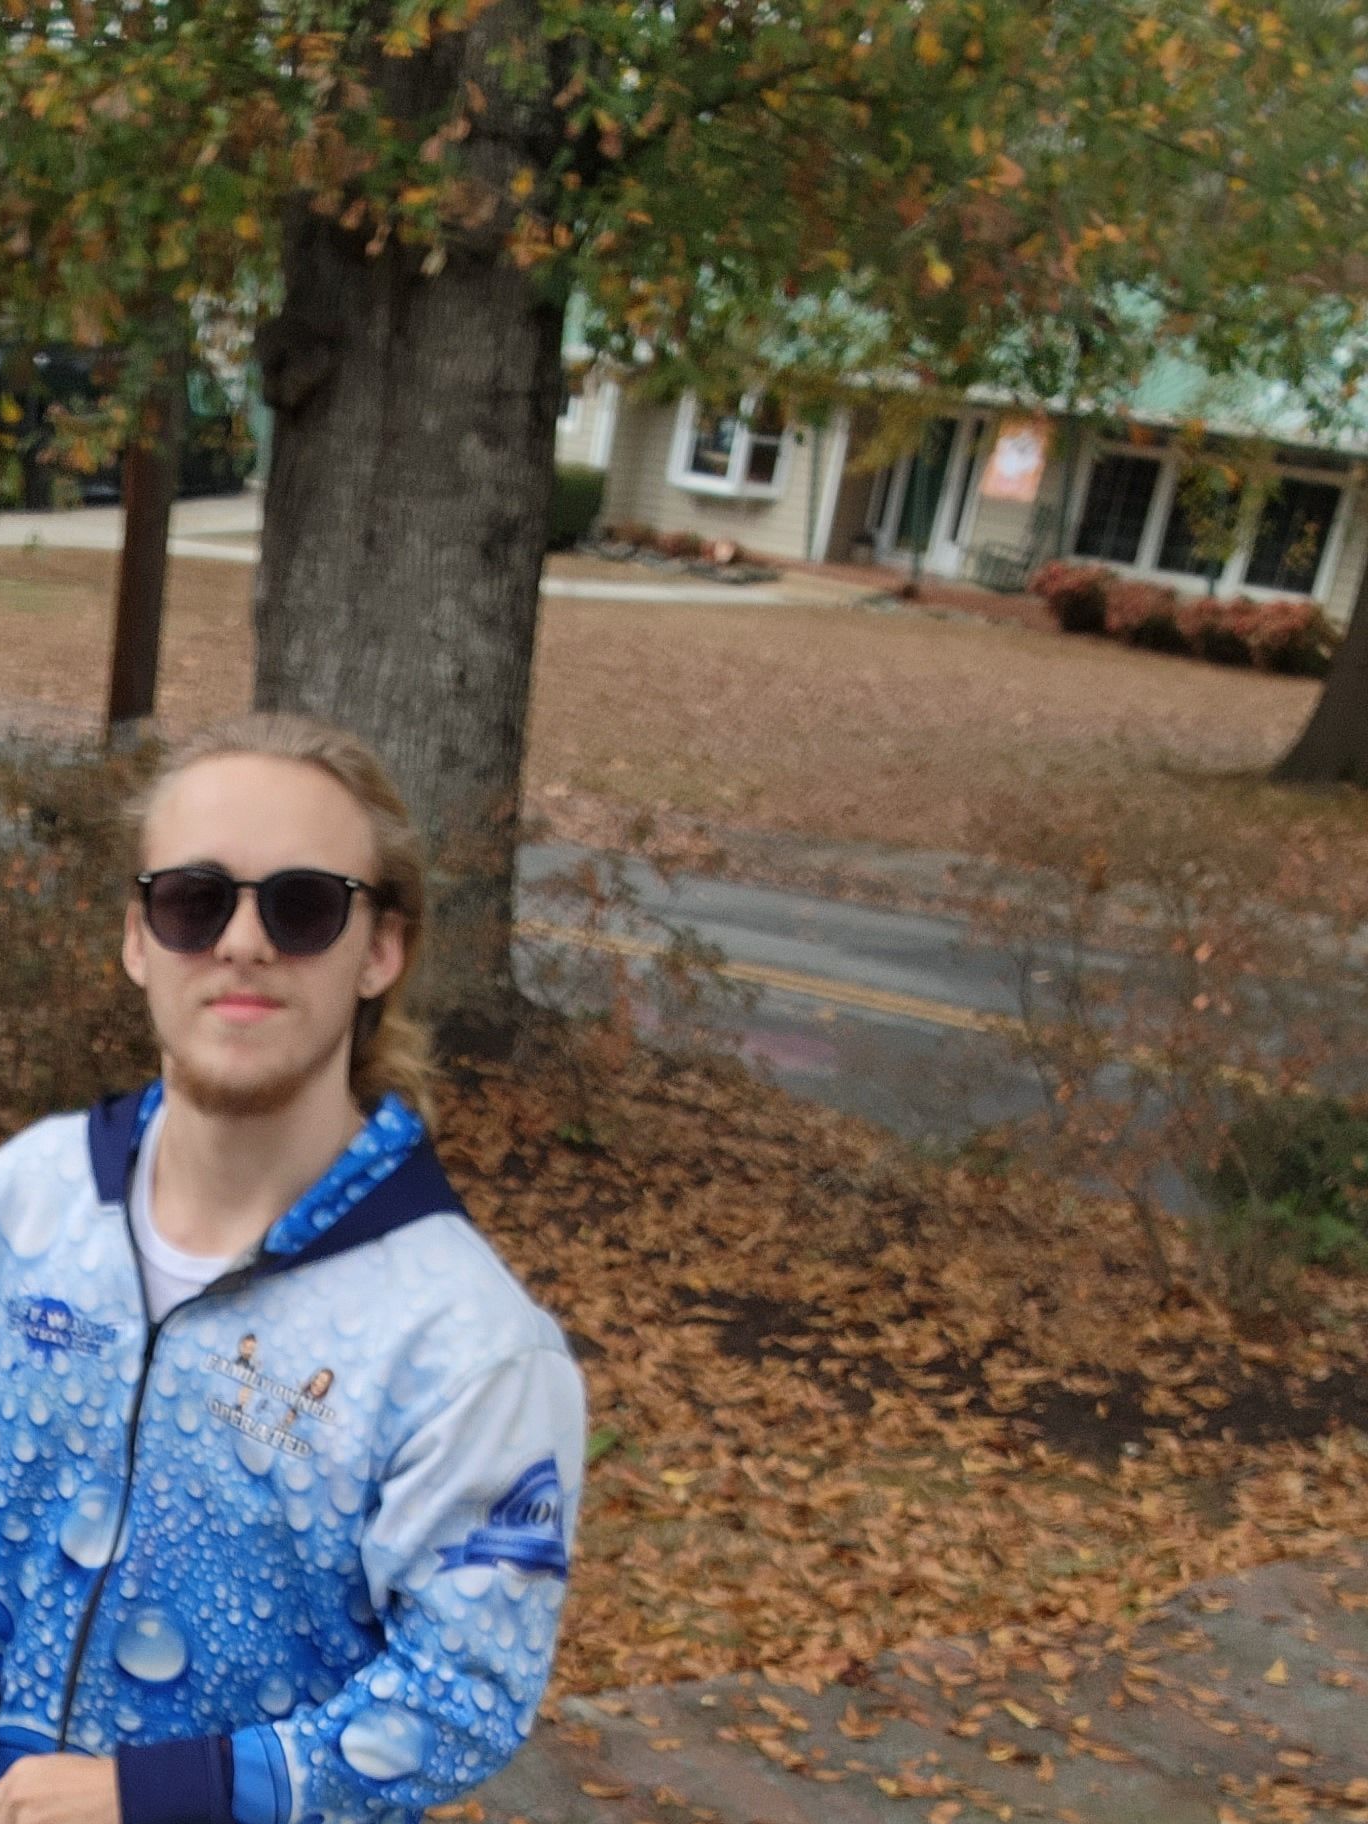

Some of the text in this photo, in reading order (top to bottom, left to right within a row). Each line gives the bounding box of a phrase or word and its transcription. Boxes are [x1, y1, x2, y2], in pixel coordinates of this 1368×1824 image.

[203, 1352, 336, 1423] FAMILY OWNED
[206, 1399, 313, 1459] OPERATED
